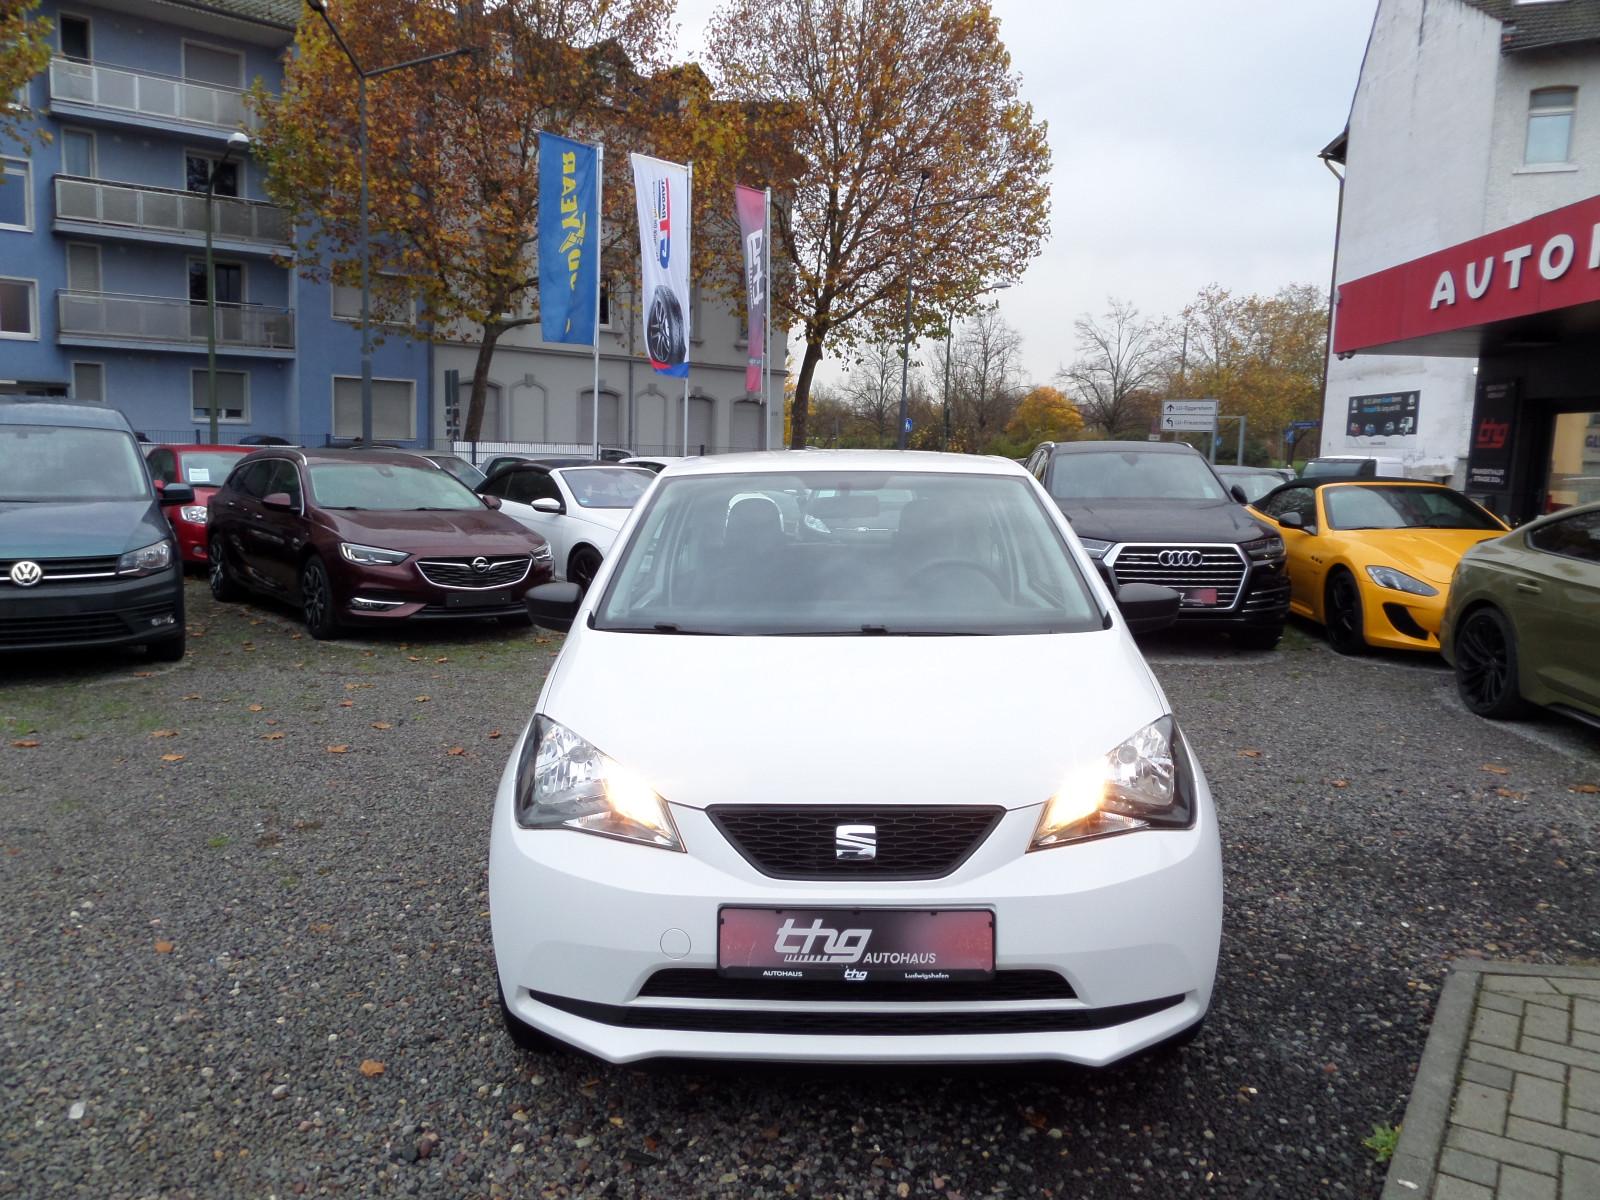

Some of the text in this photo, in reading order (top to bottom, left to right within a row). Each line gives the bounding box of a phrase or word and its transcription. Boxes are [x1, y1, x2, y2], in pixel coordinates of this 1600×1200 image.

[774, 918, 937, 965] thg AUTOHAUS
[762, 968, 950, 981] AUTOHAUS thg Ludwigshafen
